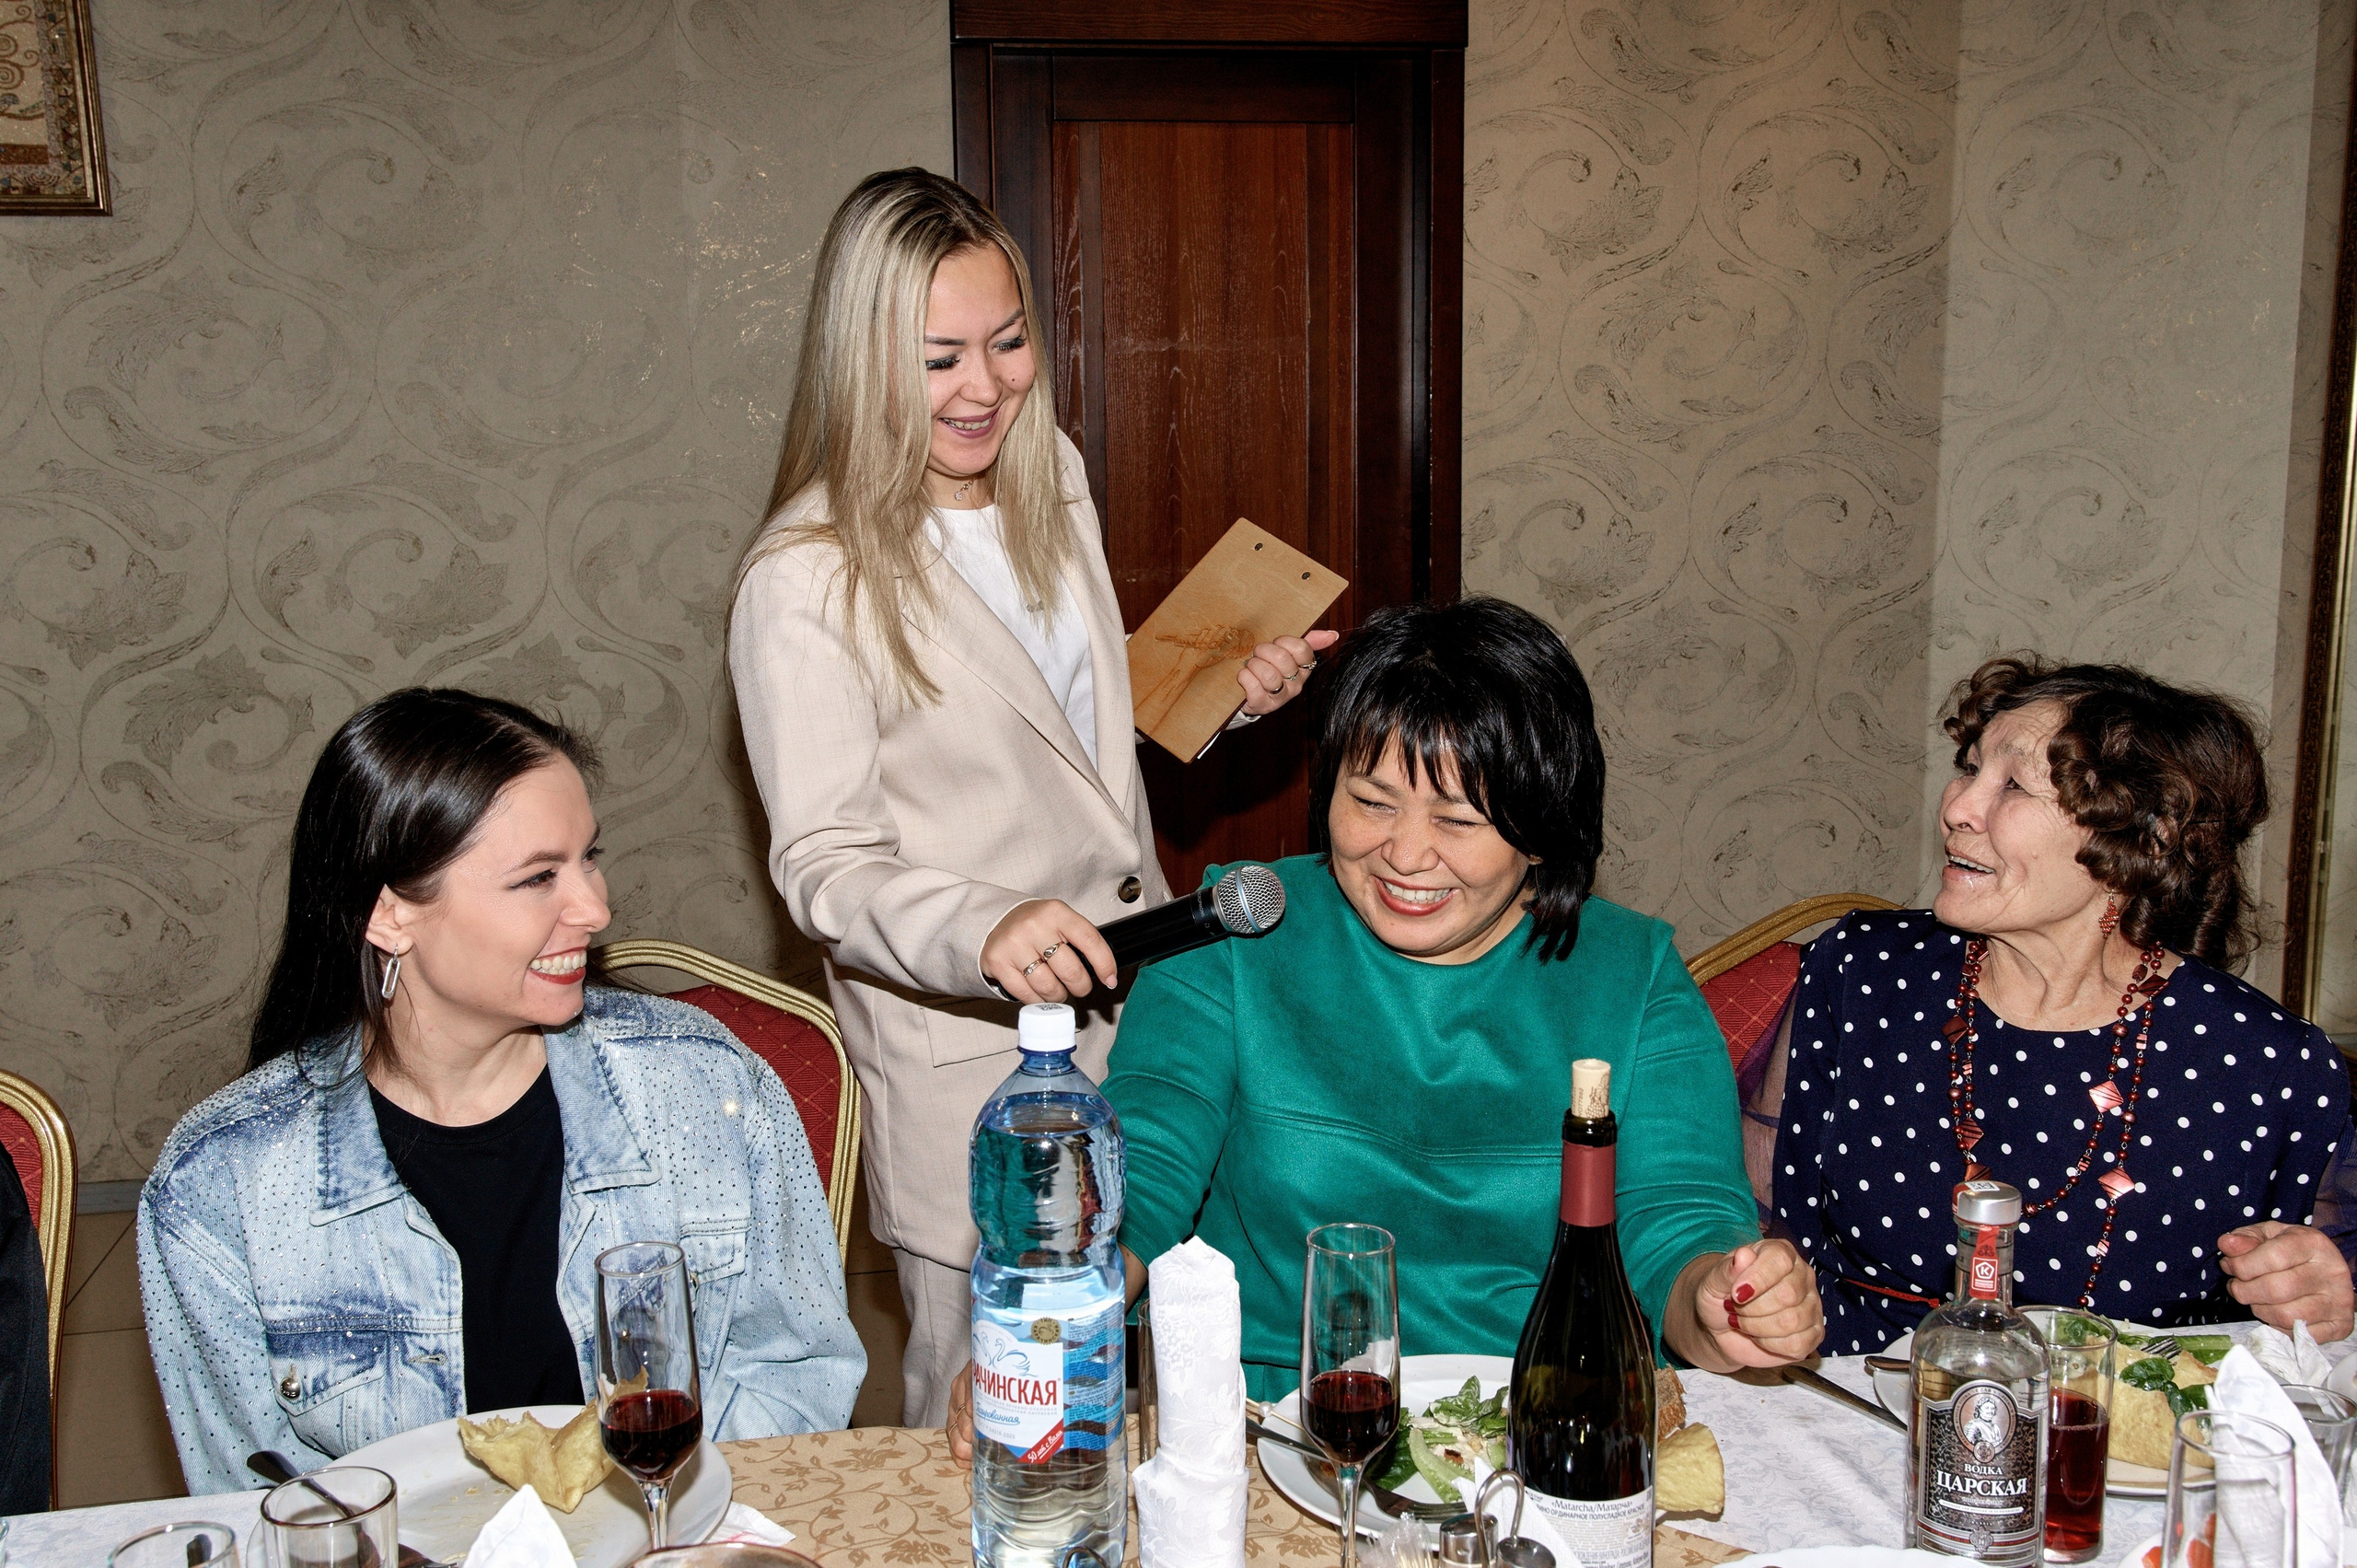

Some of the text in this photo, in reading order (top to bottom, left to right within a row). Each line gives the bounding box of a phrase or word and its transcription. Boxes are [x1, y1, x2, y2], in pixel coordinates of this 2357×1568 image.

[1028, 1450, 1038, 1463] 50
[1964, 1463, 2003, 1475] ВОДКА
[1936, 1469, 2027, 1496] ЦАРСКАЯ
[1550, 1509, 1587, 1520] ОРДИНАРНОЕ
[1589, 1510, 1626, 1520] ПОЛУСЛАДКОЕ
